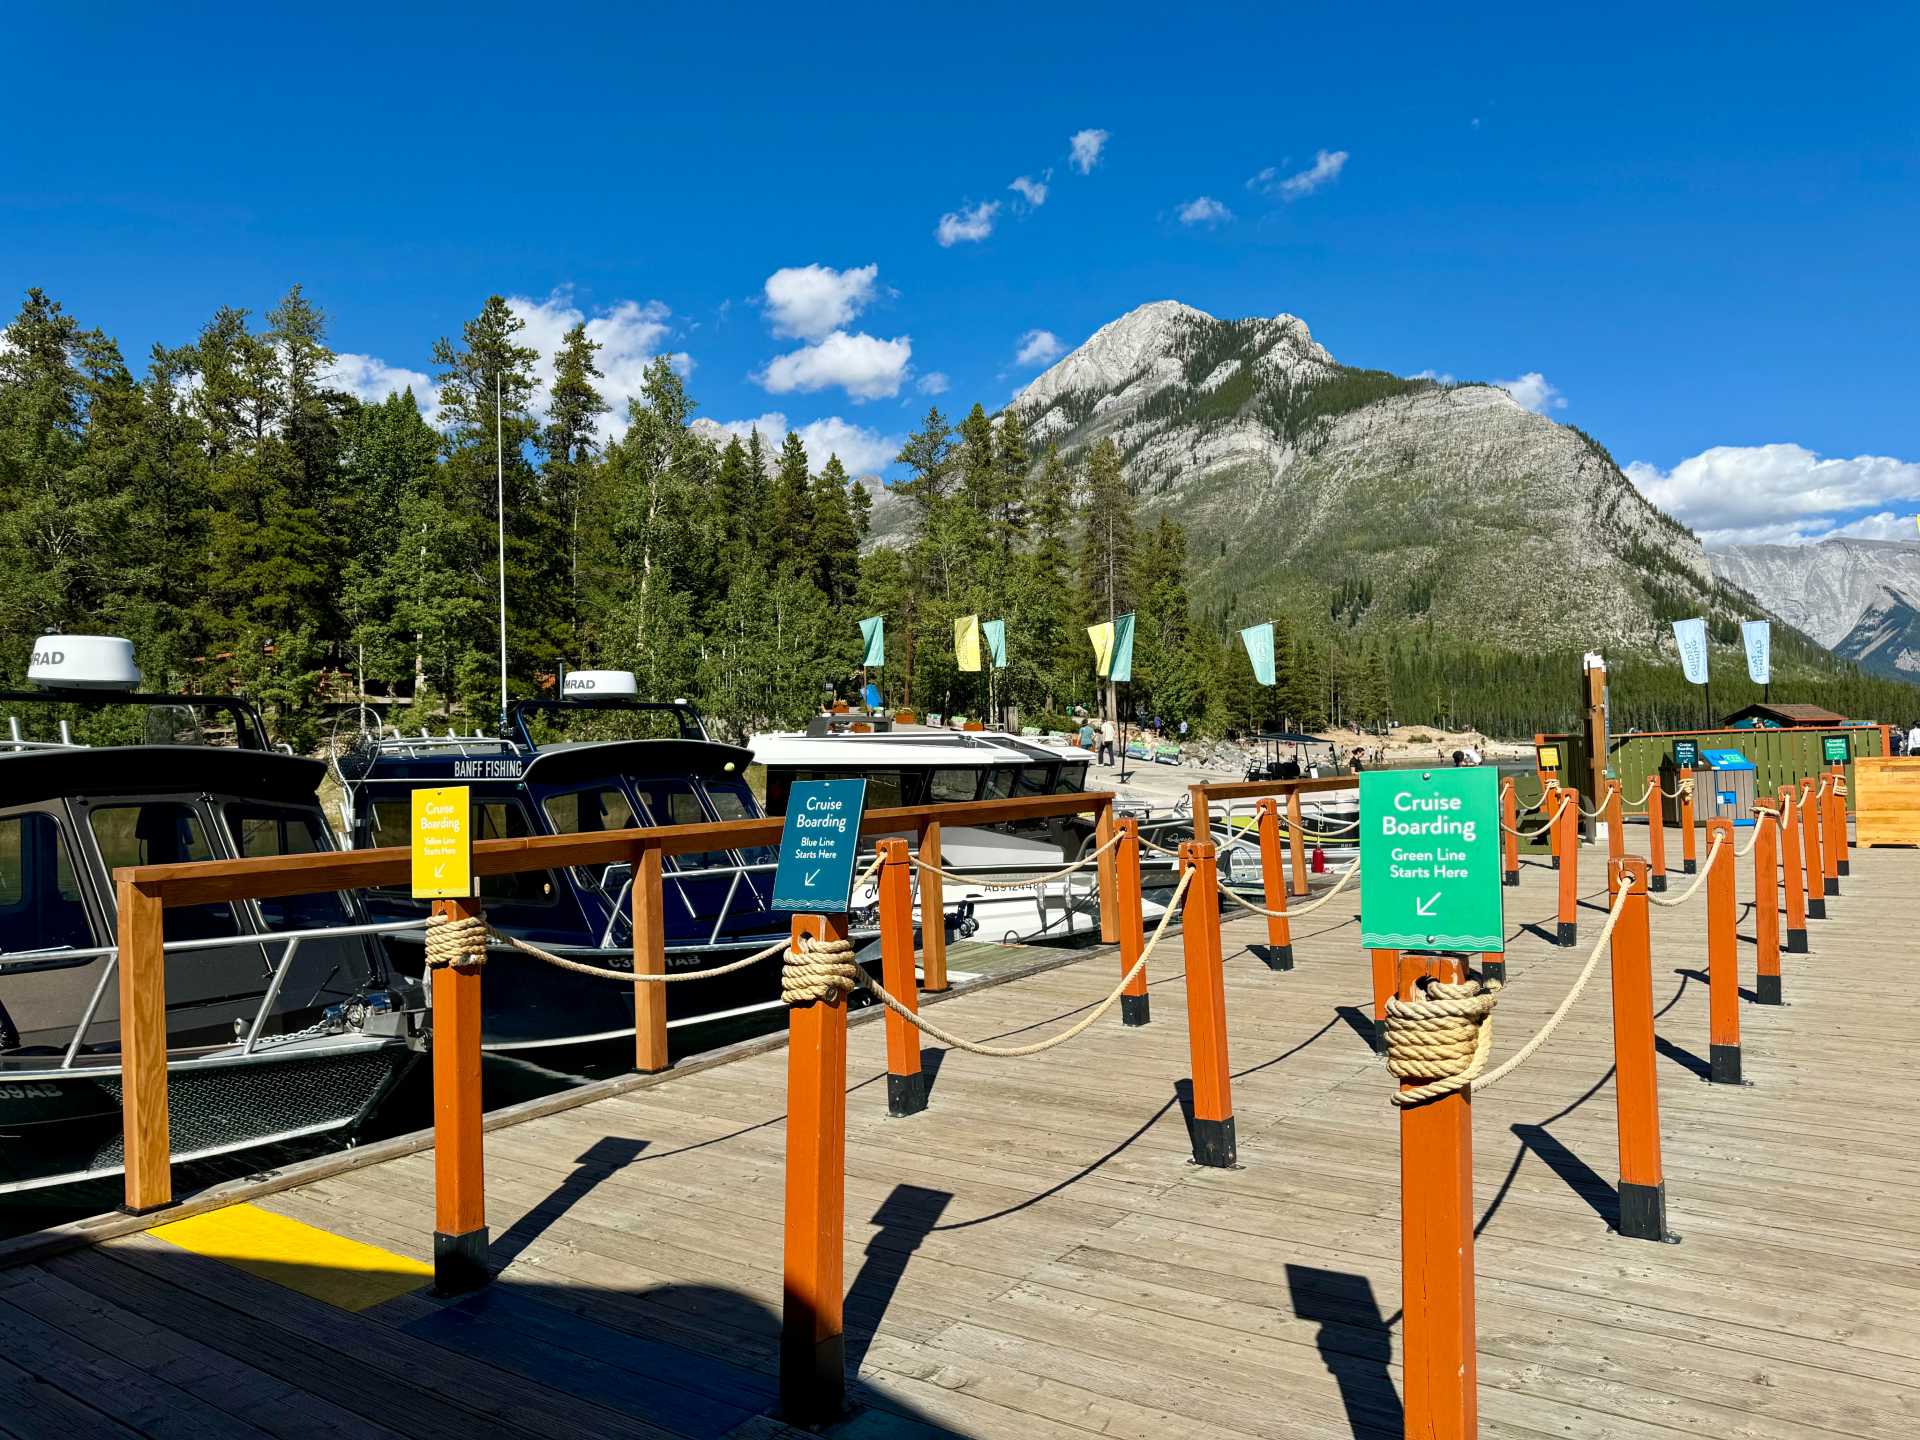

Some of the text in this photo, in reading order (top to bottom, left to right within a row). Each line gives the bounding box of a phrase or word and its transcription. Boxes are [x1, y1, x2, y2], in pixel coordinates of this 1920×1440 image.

[31, 651, 65, 666] RAD
[454, 760, 522, 777] BANFF FISHING
[425, 801, 455, 815] Cruise
[806, 796, 842, 811] Cruise
[1394, 791, 1462, 811] Cruise
[420, 816, 460, 832] Boarding
[796, 813, 846, 832] Boarding
[1382, 815, 1476, 842] Boarding
[801, 837, 835, 847] Blue Line
[795, 848, 837, 859] Starts Here
[1391, 847, 1466, 861] Green Line
[1390, 864, 1469, 878] Starts Here
